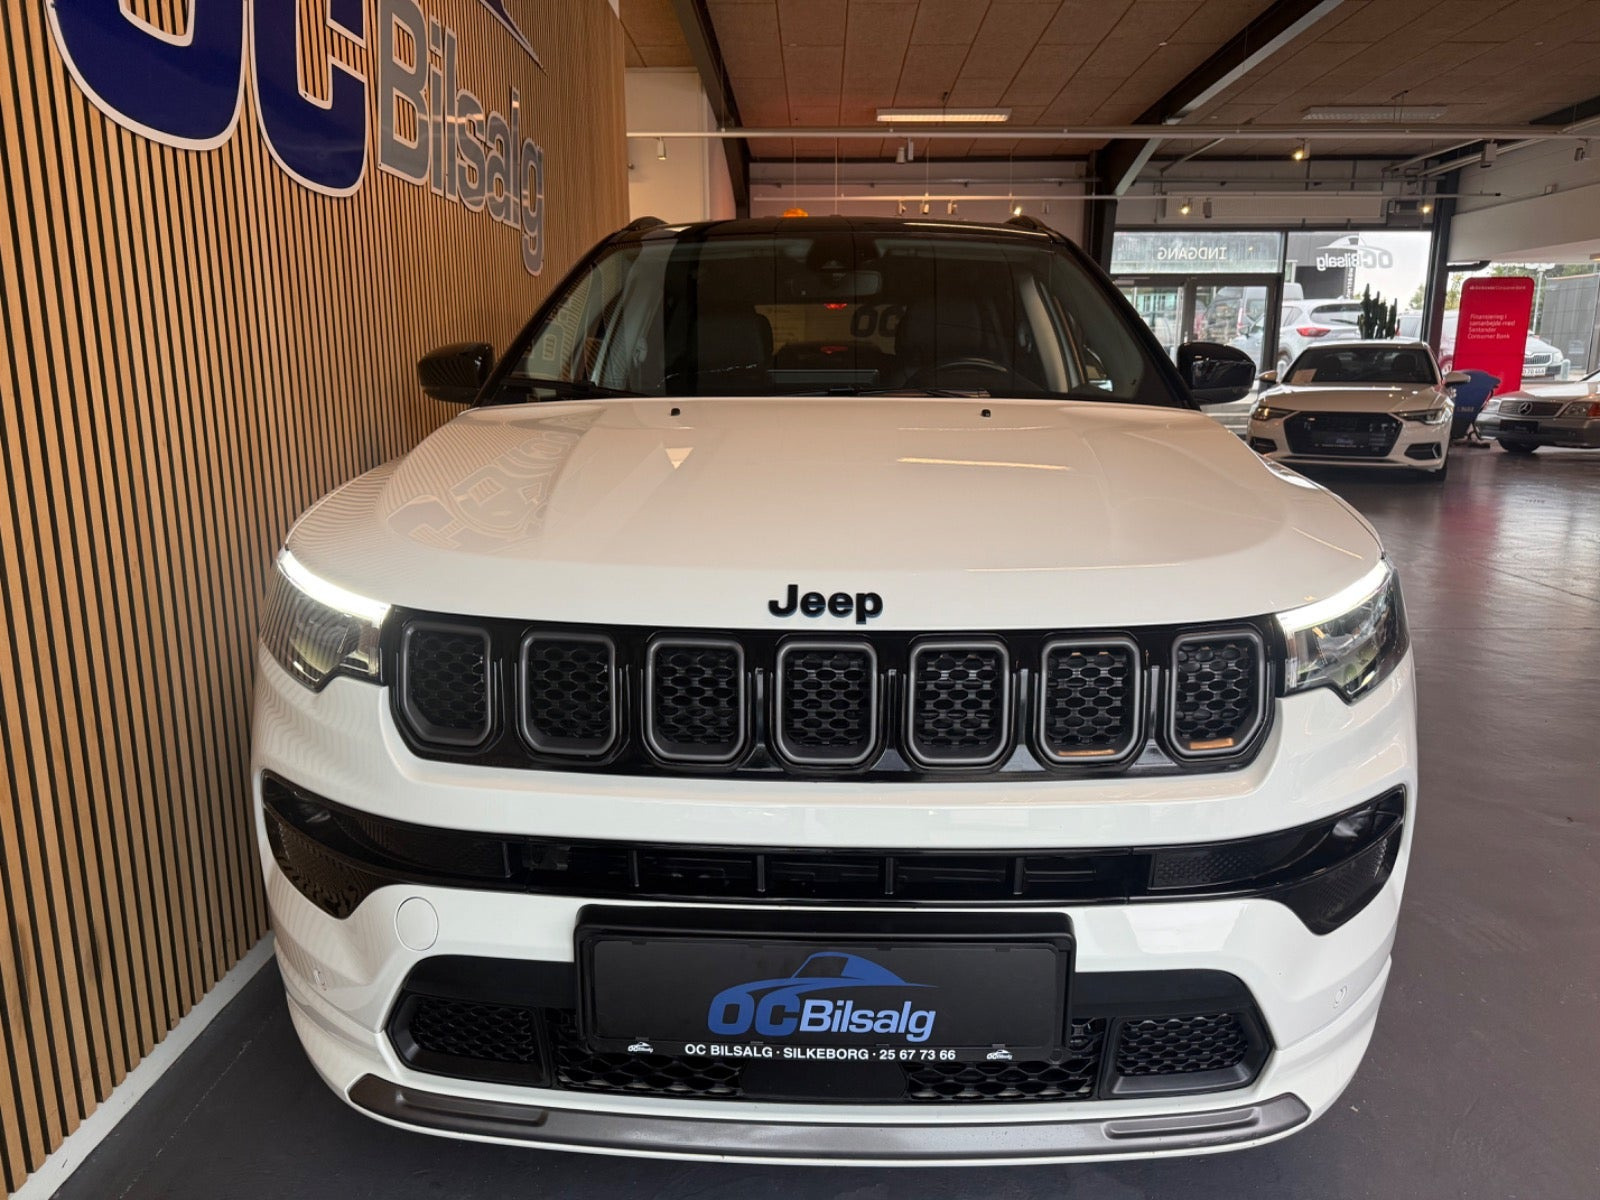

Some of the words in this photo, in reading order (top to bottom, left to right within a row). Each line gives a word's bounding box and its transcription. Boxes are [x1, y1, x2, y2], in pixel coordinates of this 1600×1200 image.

[768, 584, 883, 625] Jeep
[684, 1043, 707, 1055] OC
[710, 1045, 773, 1058] BILSALG
[783, 1047, 869, 1060] SILKEBORG
[879, 1050, 896, 1060] 25
[899, 1050, 915, 1060] 67
[919, 1050, 936, 1060] 73
[939, 1050, 956, 1060] 66
